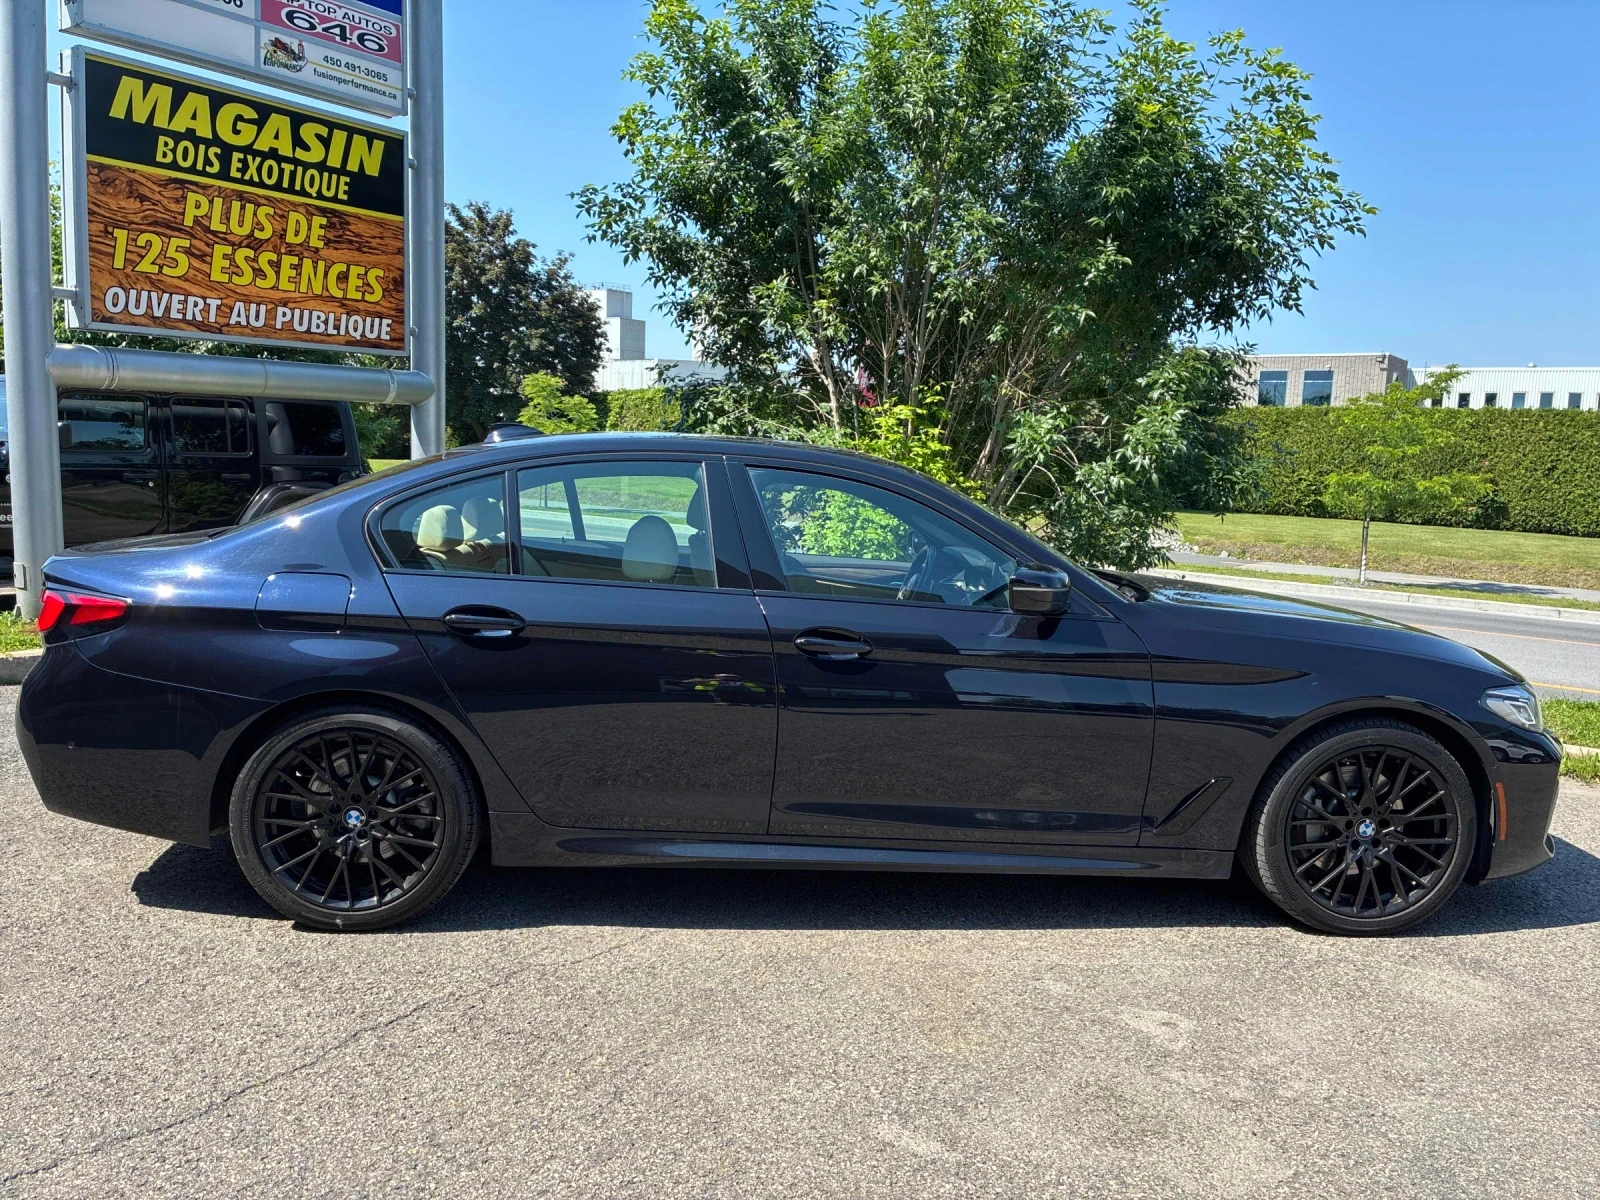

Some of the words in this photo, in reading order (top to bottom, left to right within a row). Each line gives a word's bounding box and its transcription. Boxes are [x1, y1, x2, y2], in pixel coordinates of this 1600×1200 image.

[285, 9, 388, 53] 646
[342, 12, 393, 36] AUTOS
[313, 67, 397, 100] fusionperformance.ca
[323, 55, 342, 67] 450
[344, 62, 388, 82] 491-3065
[109, 75, 385, 177] MAGASIN
[156, 135, 221, 174] BOIS
[230, 151, 350, 200] EXOTIQUE
[183, 191, 275, 240] PLUS
[285, 211, 328, 249] DE
[112, 228, 191, 277] 125
[209, 244, 385, 303] ESSENCES
[104, 286, 222, 323] OUVERT
[229, 301, 267, 329] AU
[275, 306, 393, 341] PUBLIQUE
